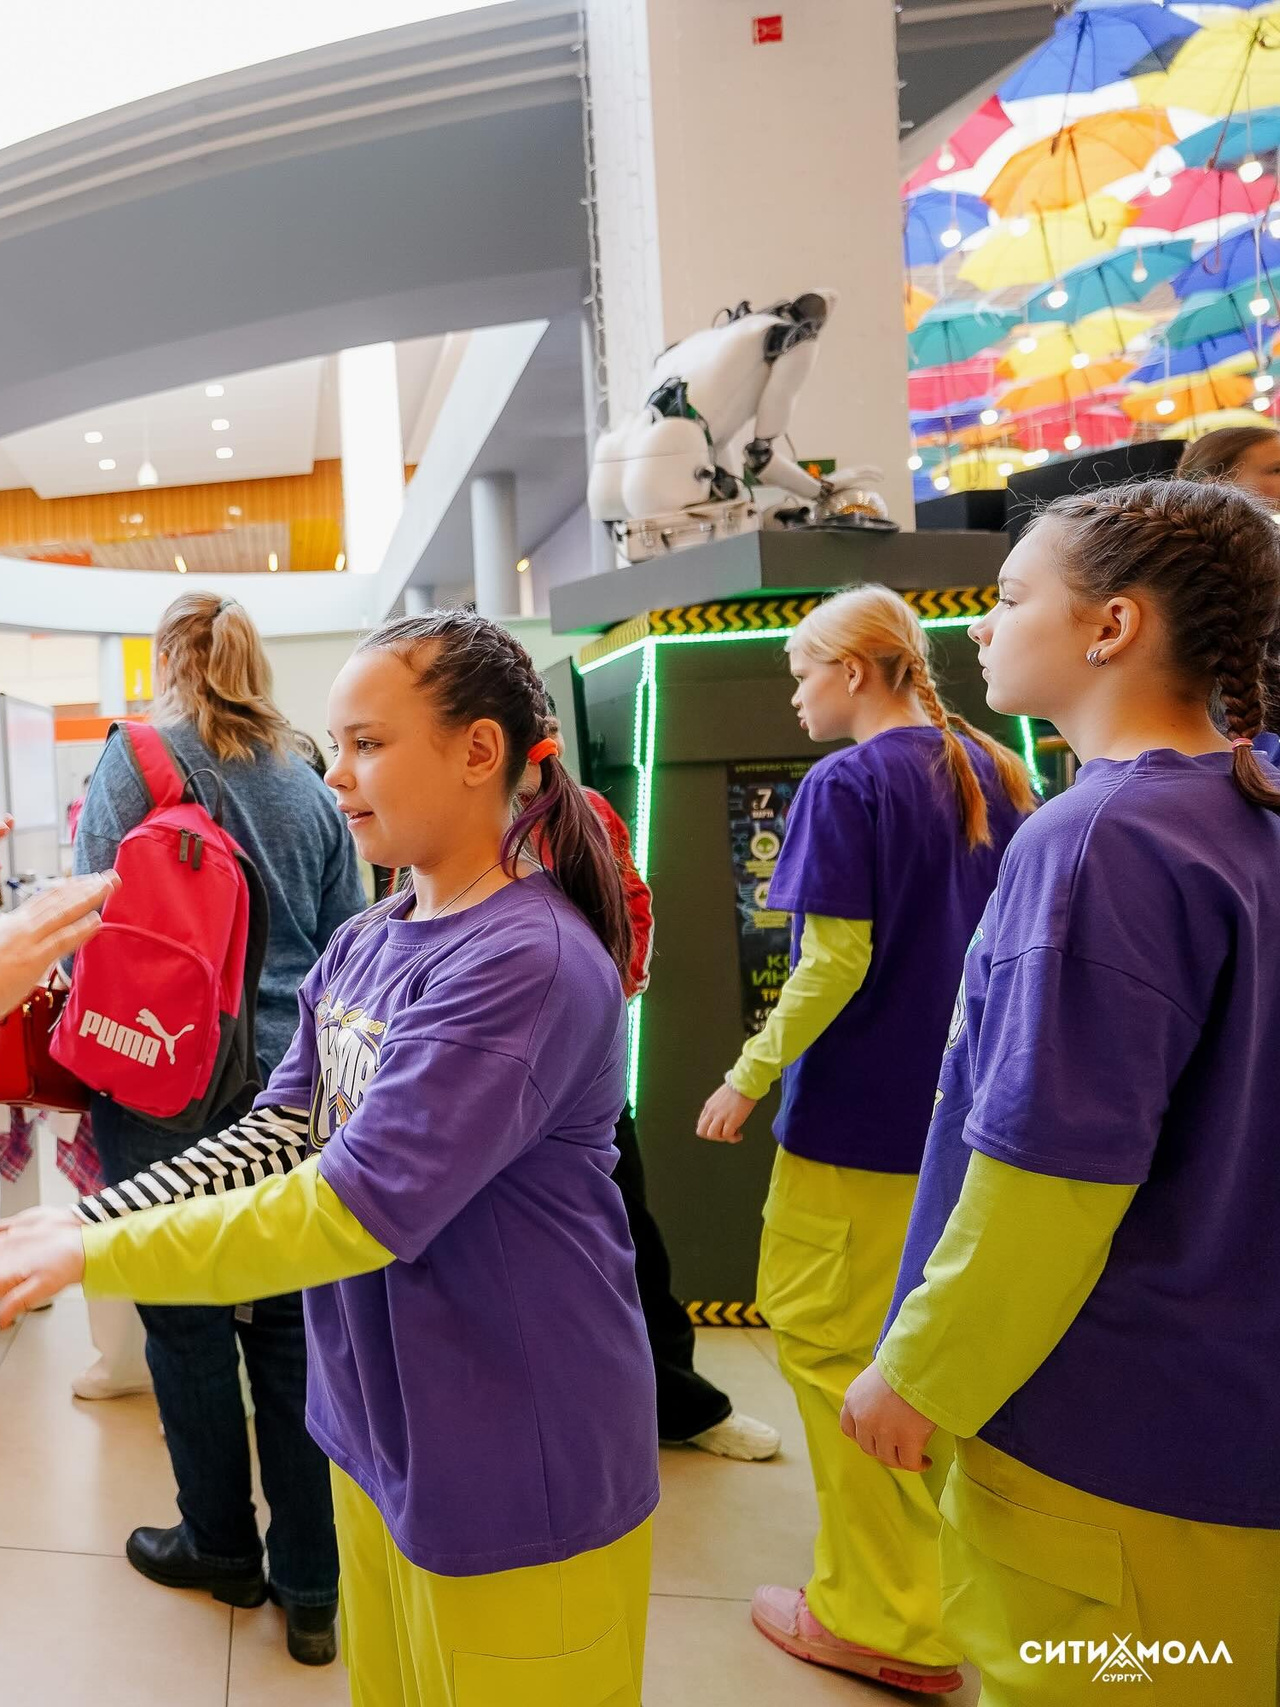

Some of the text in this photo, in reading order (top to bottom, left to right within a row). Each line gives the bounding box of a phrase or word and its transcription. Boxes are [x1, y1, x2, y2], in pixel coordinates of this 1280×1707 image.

[757, 787, 772, 809] 7
[751, 808, 774, 818] МАРТА
[751, 969, 790, 986] ИН
[761, 988, 782, 1001] ТР
[78, 1009, 161, 1068] PUMA
